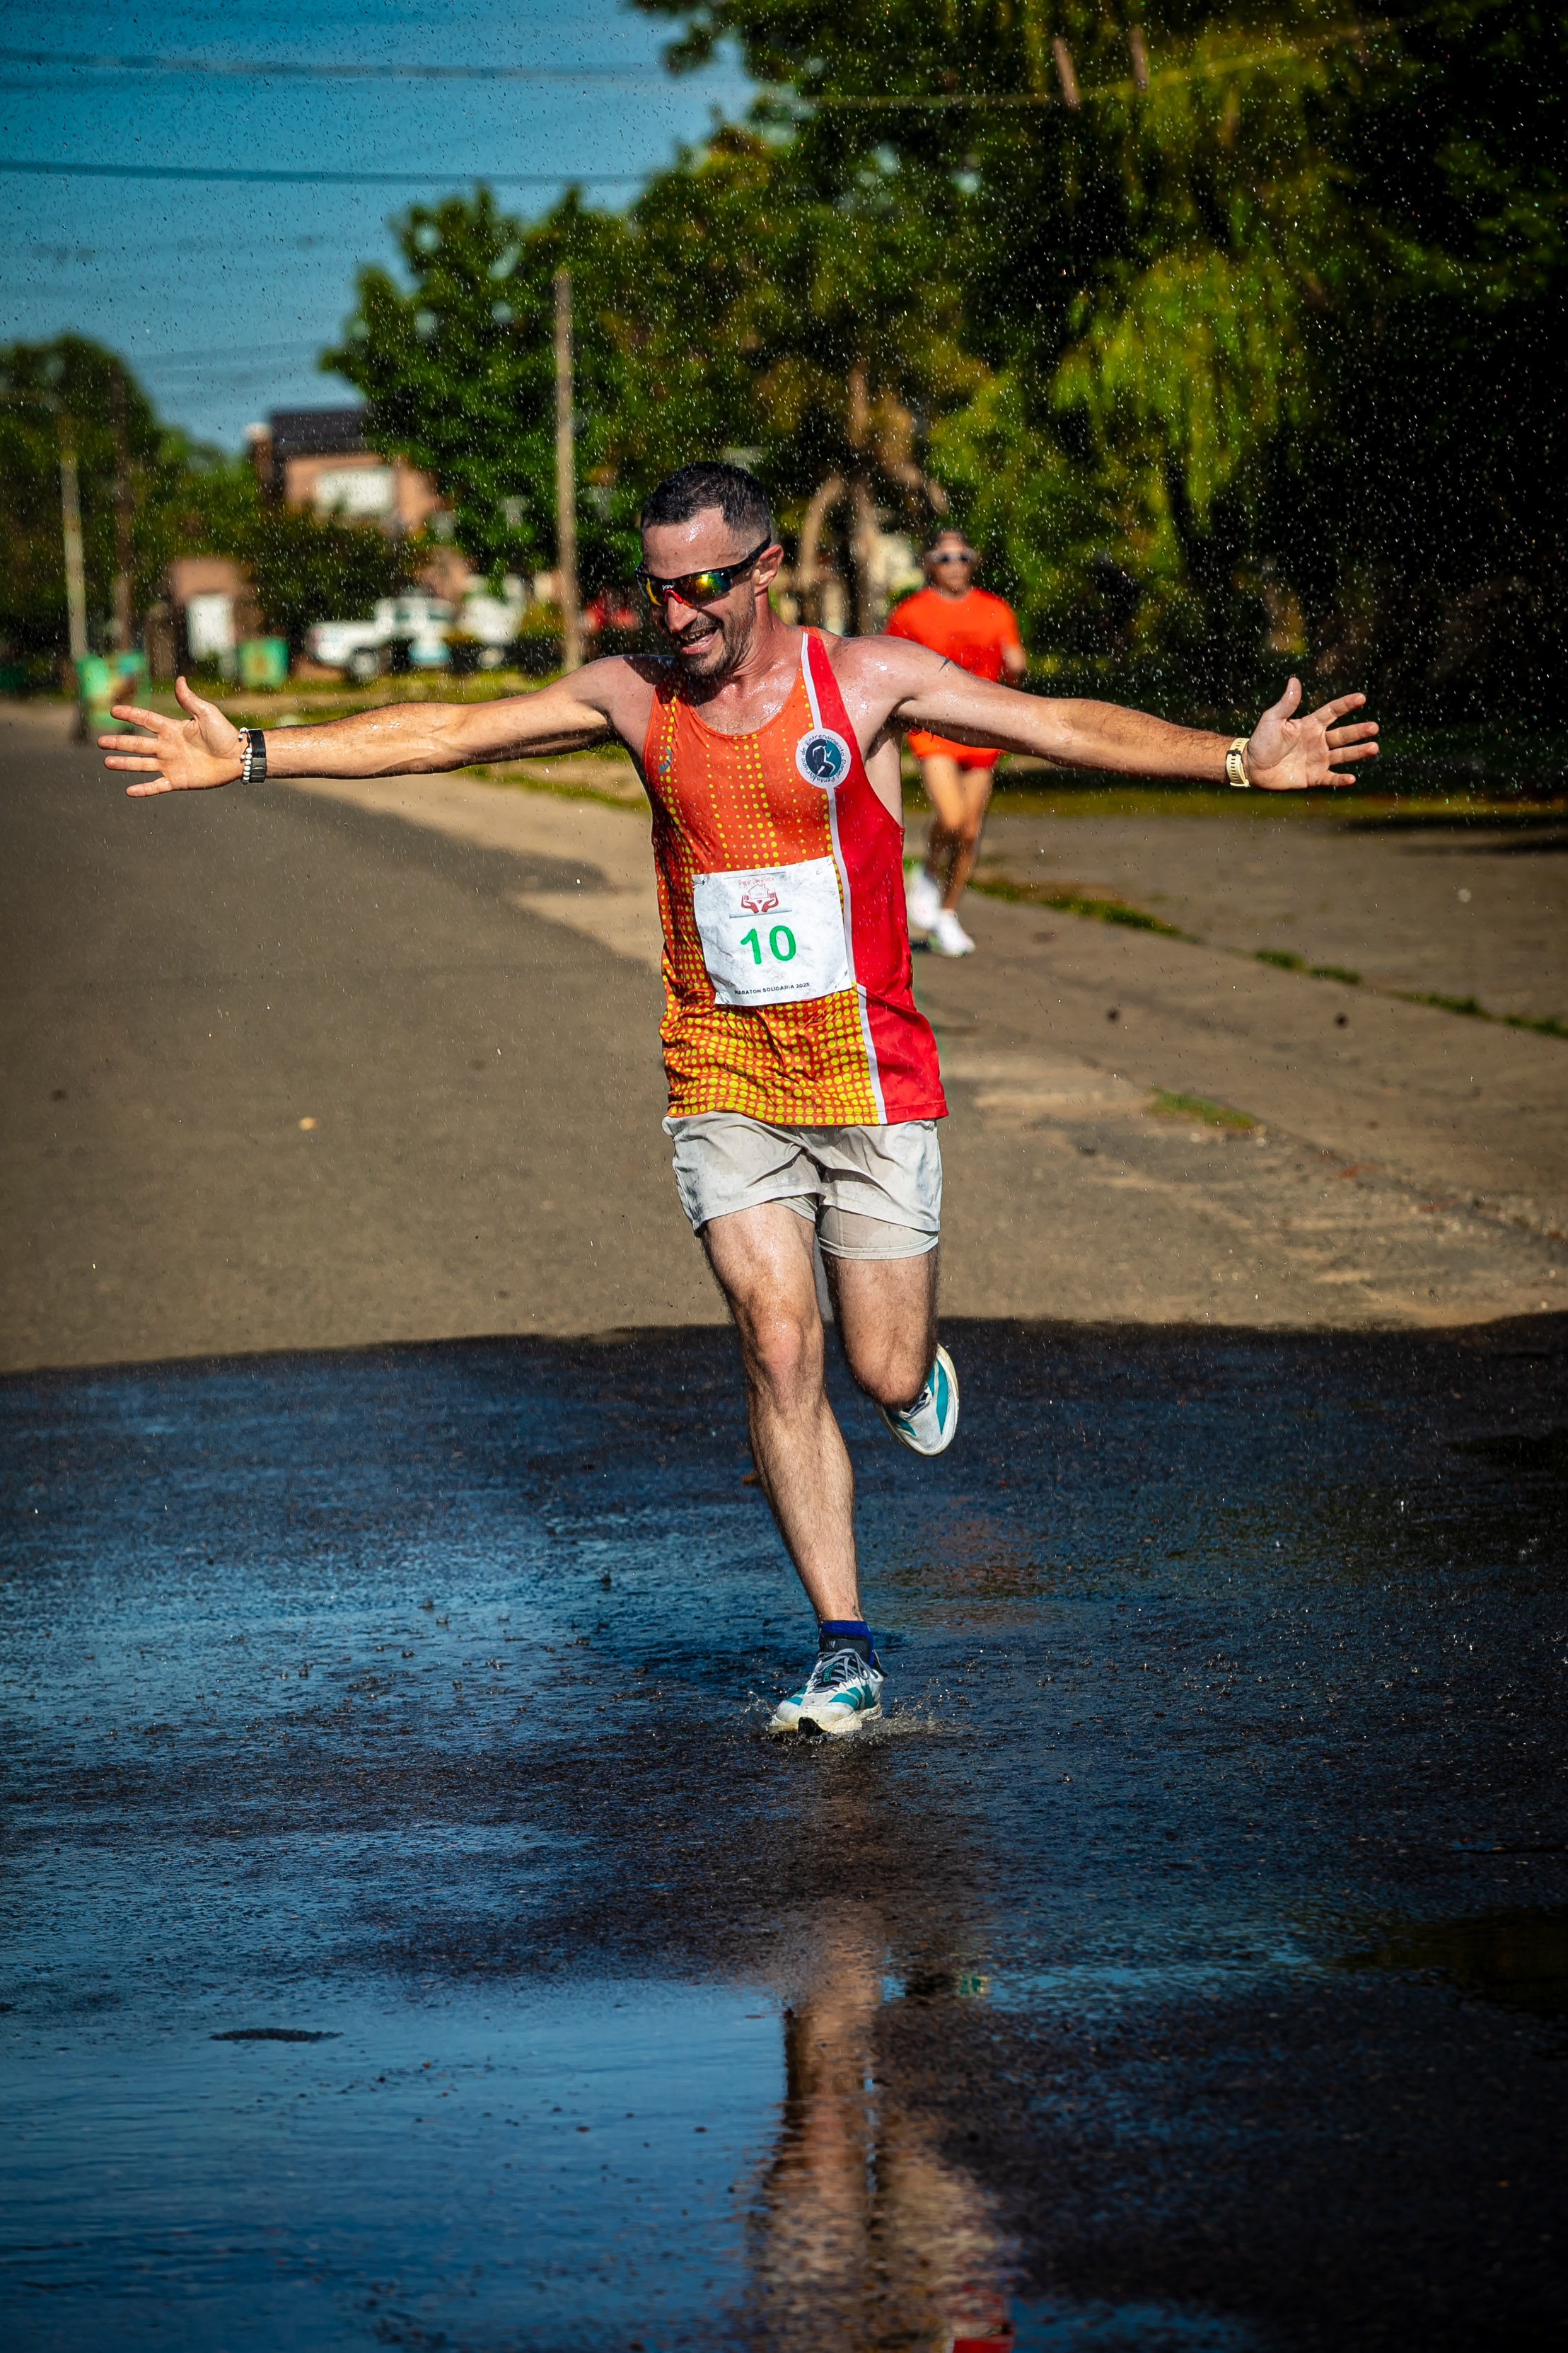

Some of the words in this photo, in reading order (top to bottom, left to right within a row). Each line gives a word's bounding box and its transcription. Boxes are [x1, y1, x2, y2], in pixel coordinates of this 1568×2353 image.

[800, 747, 806, 756] de
[805, 734, 844, 757] Entrenamiento
[801, 758, 814, 779] Grupo
[740, 925, 796, 965] 10
